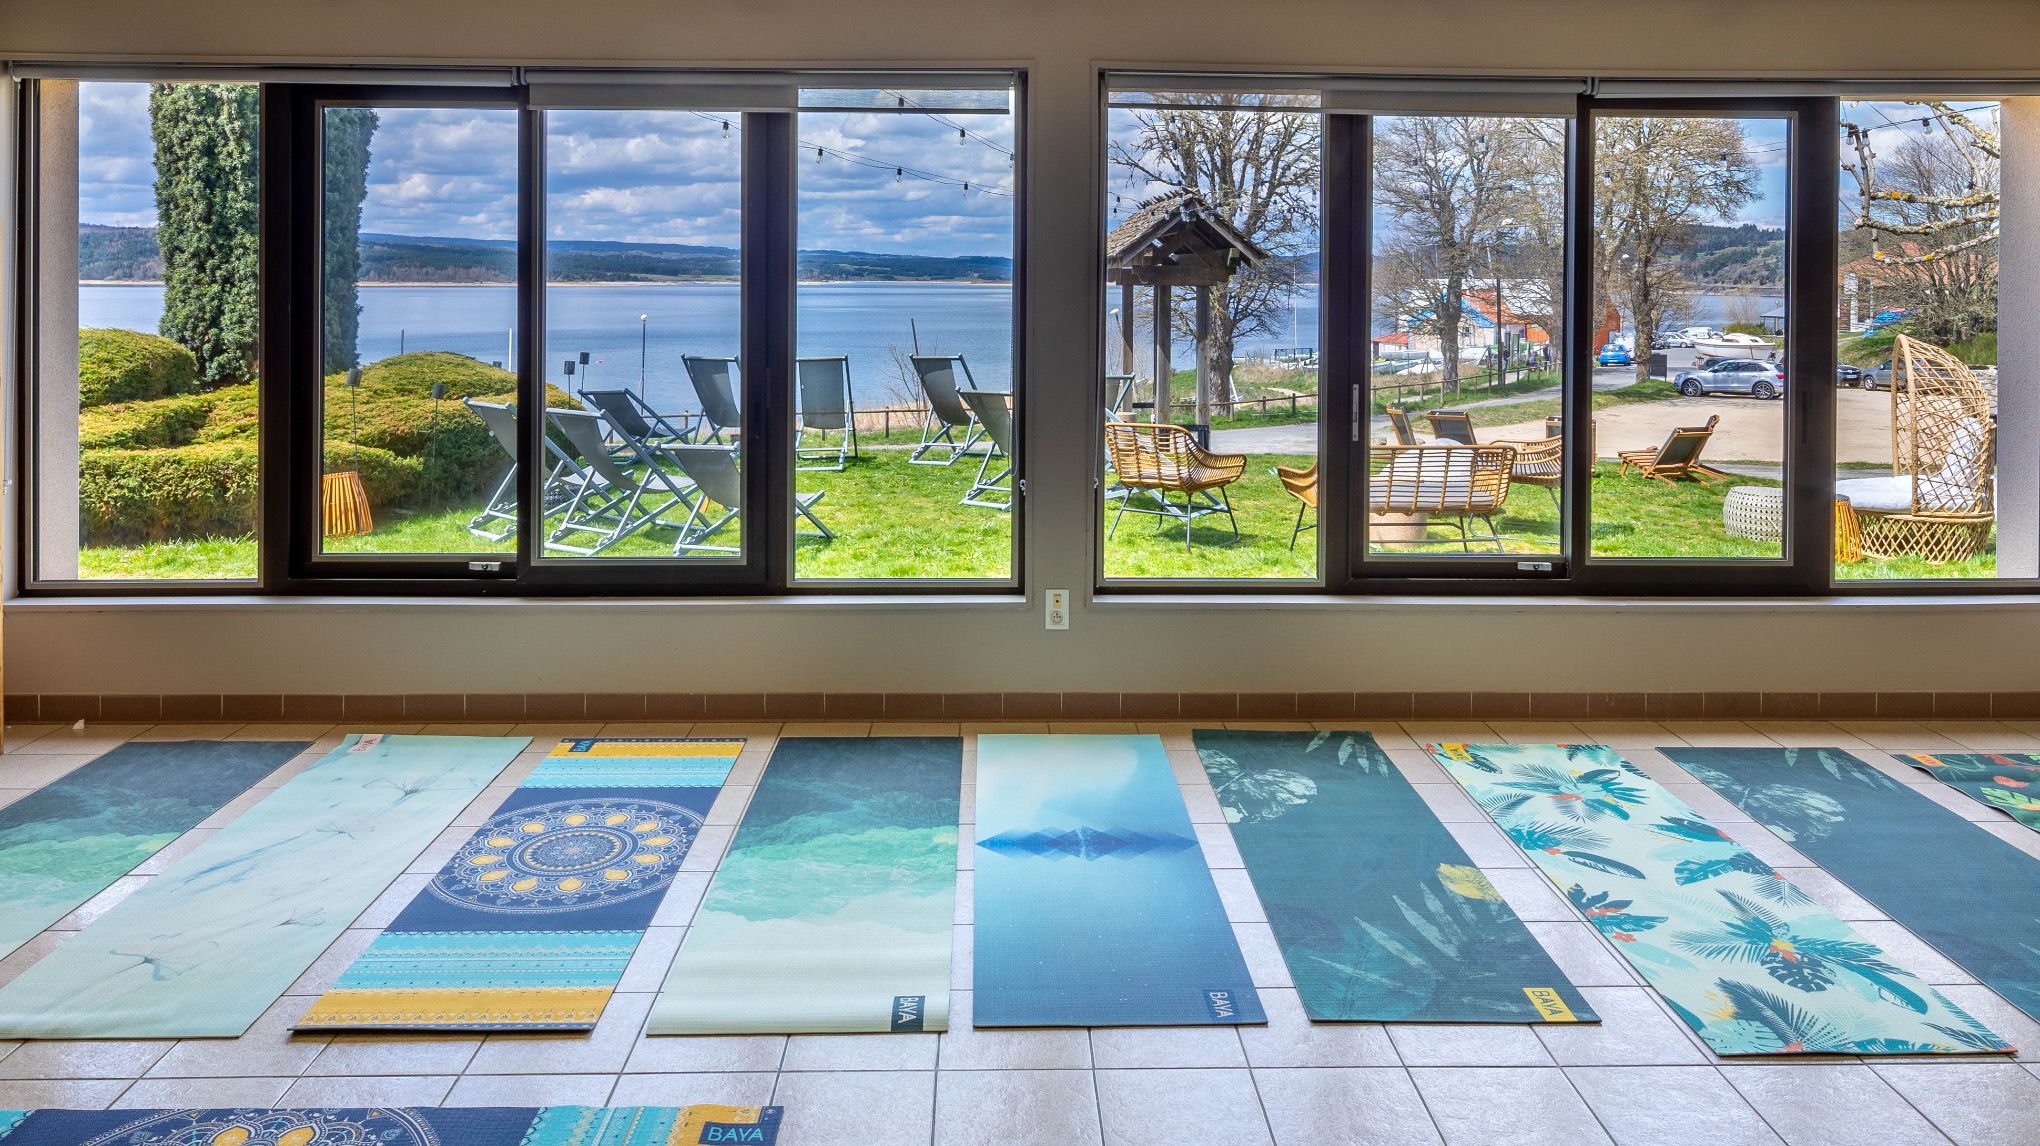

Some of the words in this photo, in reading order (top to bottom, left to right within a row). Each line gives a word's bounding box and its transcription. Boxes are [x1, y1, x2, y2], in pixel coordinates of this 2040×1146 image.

[898, 997, 919, 1024] BAYA
[1209, 992, 1234, 1018] BAYA
[1531, 990, 1564, 1016] BAYA
[707, 1126, 764, 1142] BAYA
